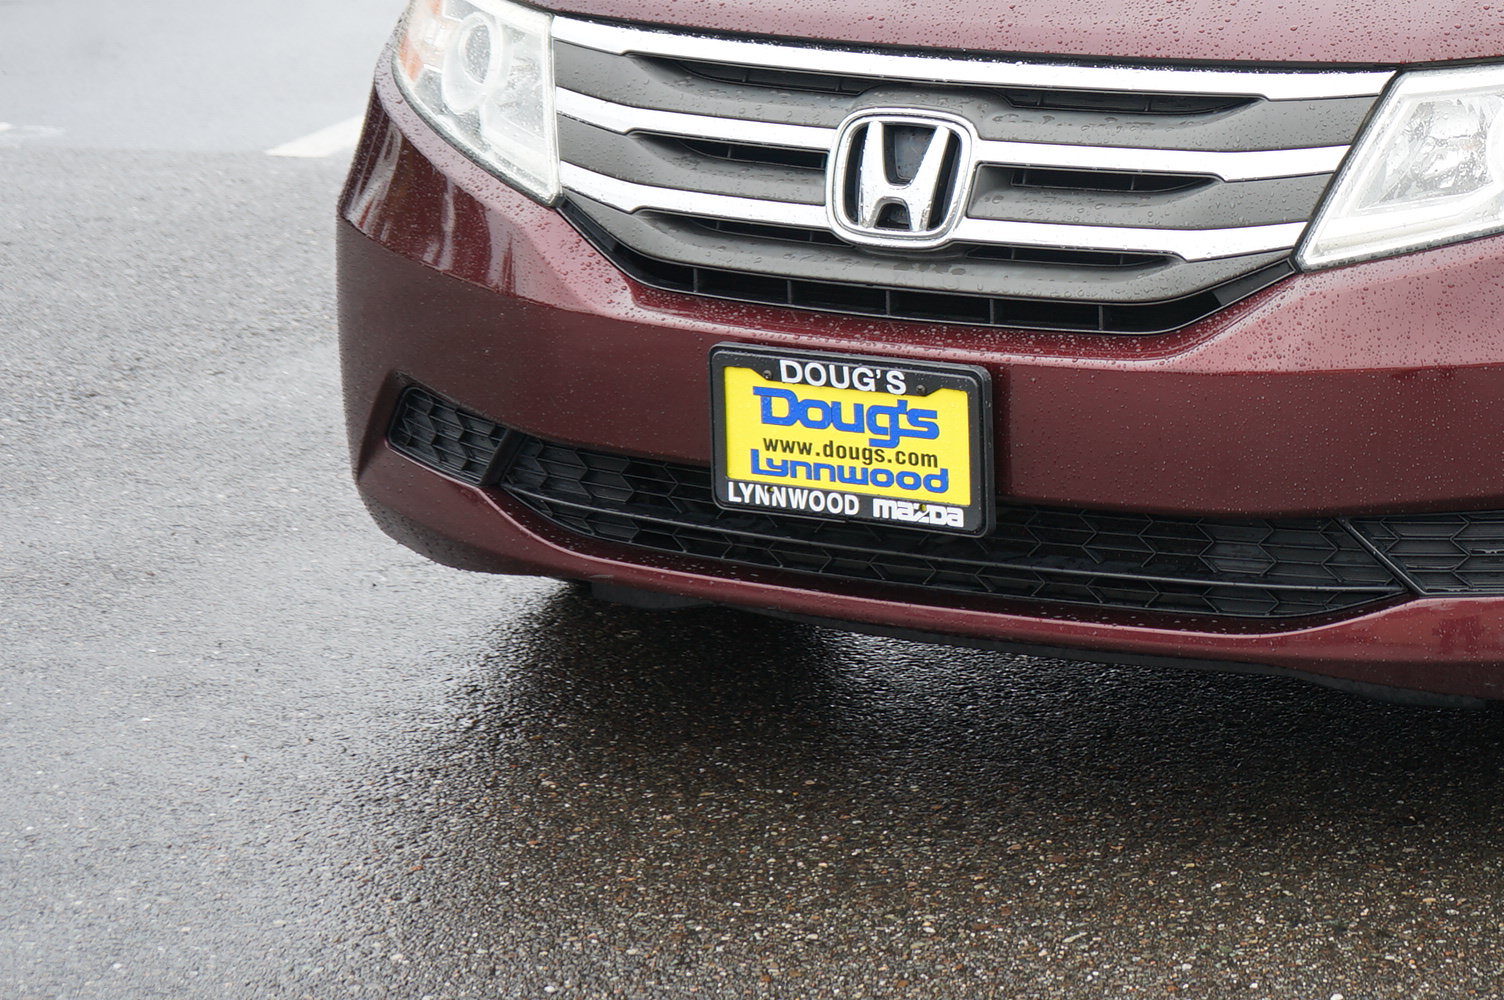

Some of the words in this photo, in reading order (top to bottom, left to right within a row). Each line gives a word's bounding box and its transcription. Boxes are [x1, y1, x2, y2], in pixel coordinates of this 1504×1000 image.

[779, 359, 907, 395] DOUG'S
[753, 386, 940, 449] Doug's
[763, 437, 938, 468] www.dougs.com
[750, 449, 949, 494] Lynnwood
[728, 481, 860, 515] LYNNWOOD
